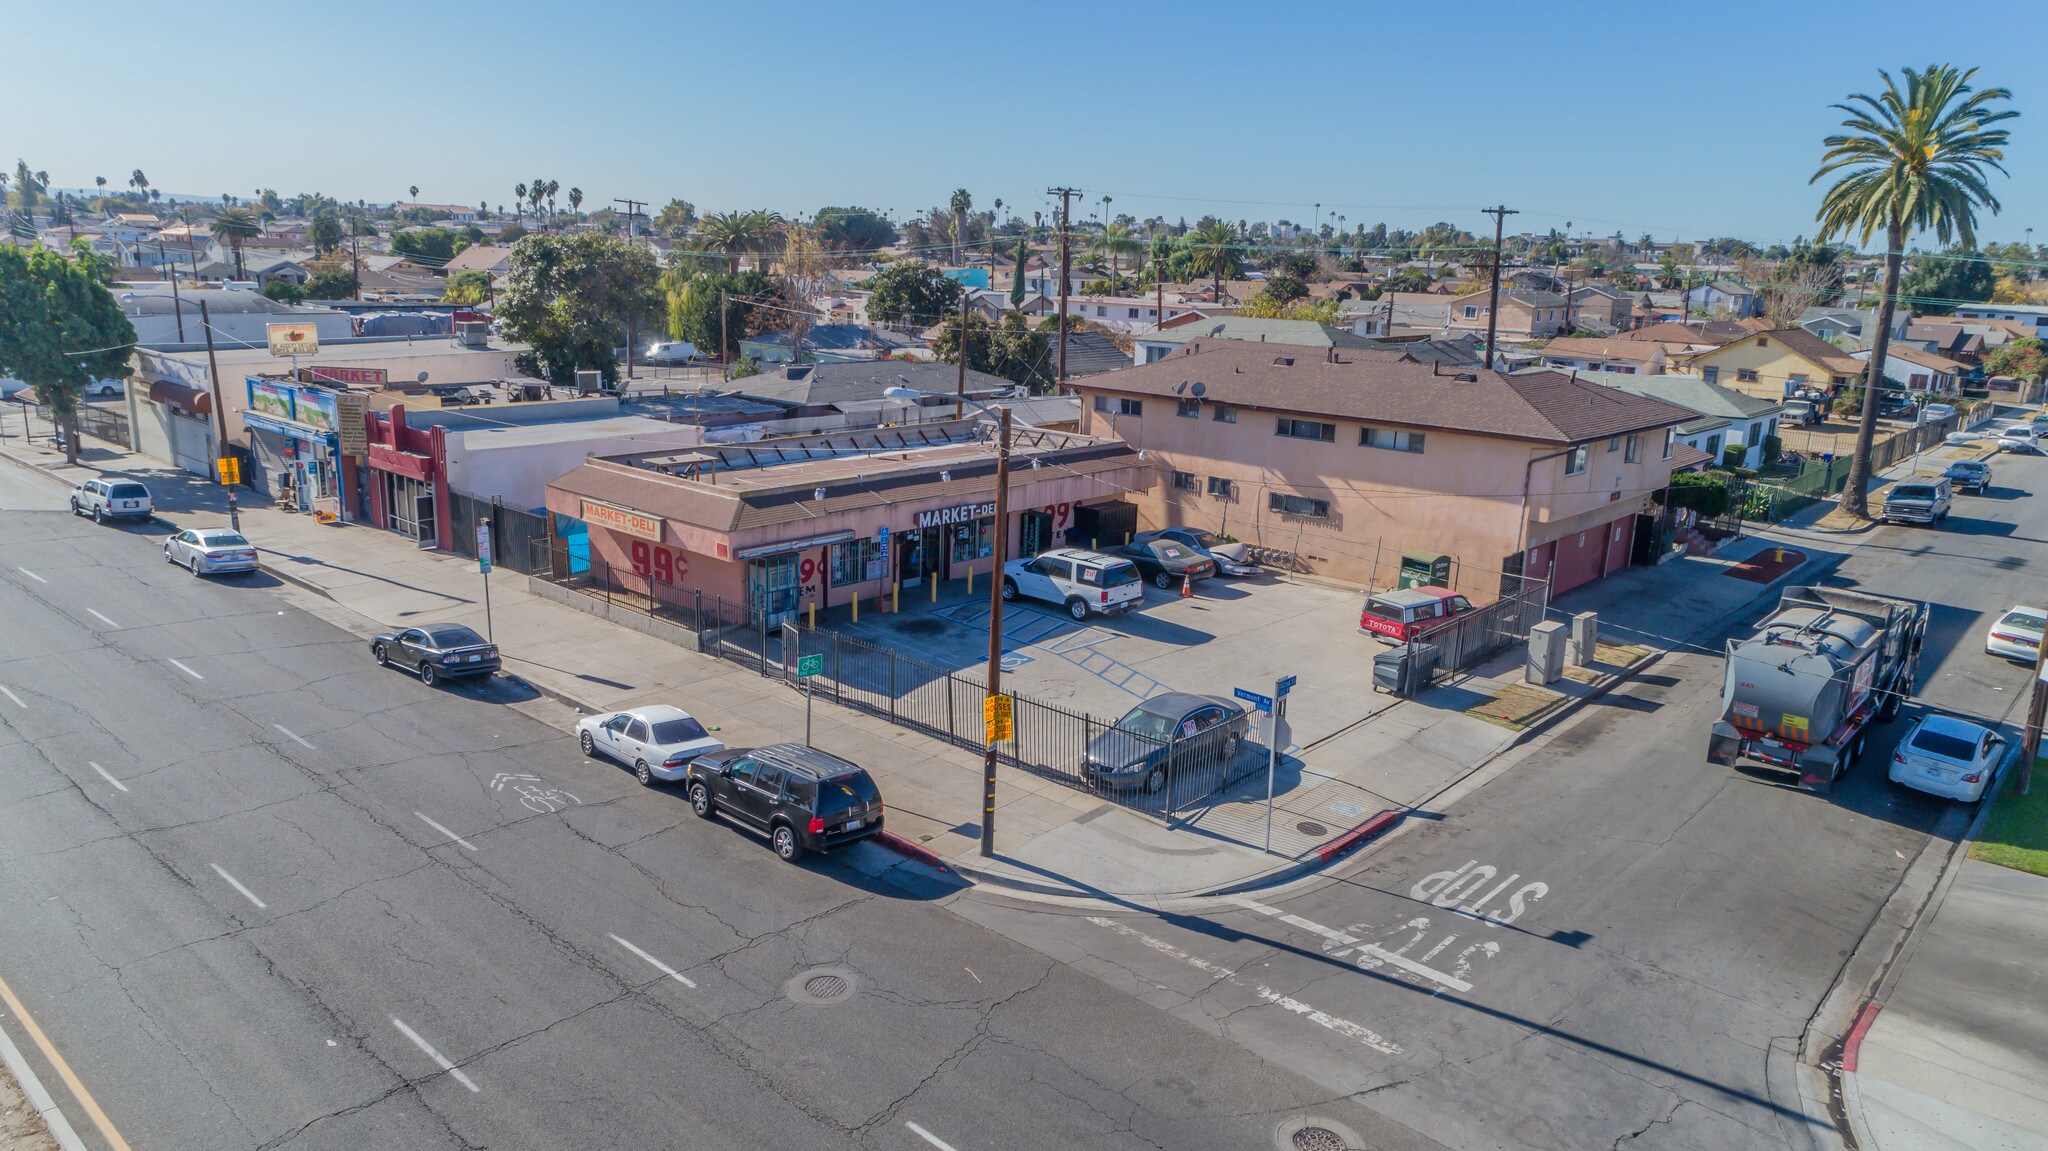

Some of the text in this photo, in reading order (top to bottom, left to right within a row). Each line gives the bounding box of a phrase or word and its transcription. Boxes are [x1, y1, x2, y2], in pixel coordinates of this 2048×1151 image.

[313, 368, 383, 383] MARKET
[585, 503, 656, 533] MARKET-DELI
[919, 503, 997, 529] MARKET-DE
[800, 585, 816, 597] EM
[1369, 619, 1396, 634] TOYOTA
[1236, 689, 1271, 706] Vermont Av
[985, 703, 1011, 713] HOUSES
[1409, 859, 1549, 928] STOP
